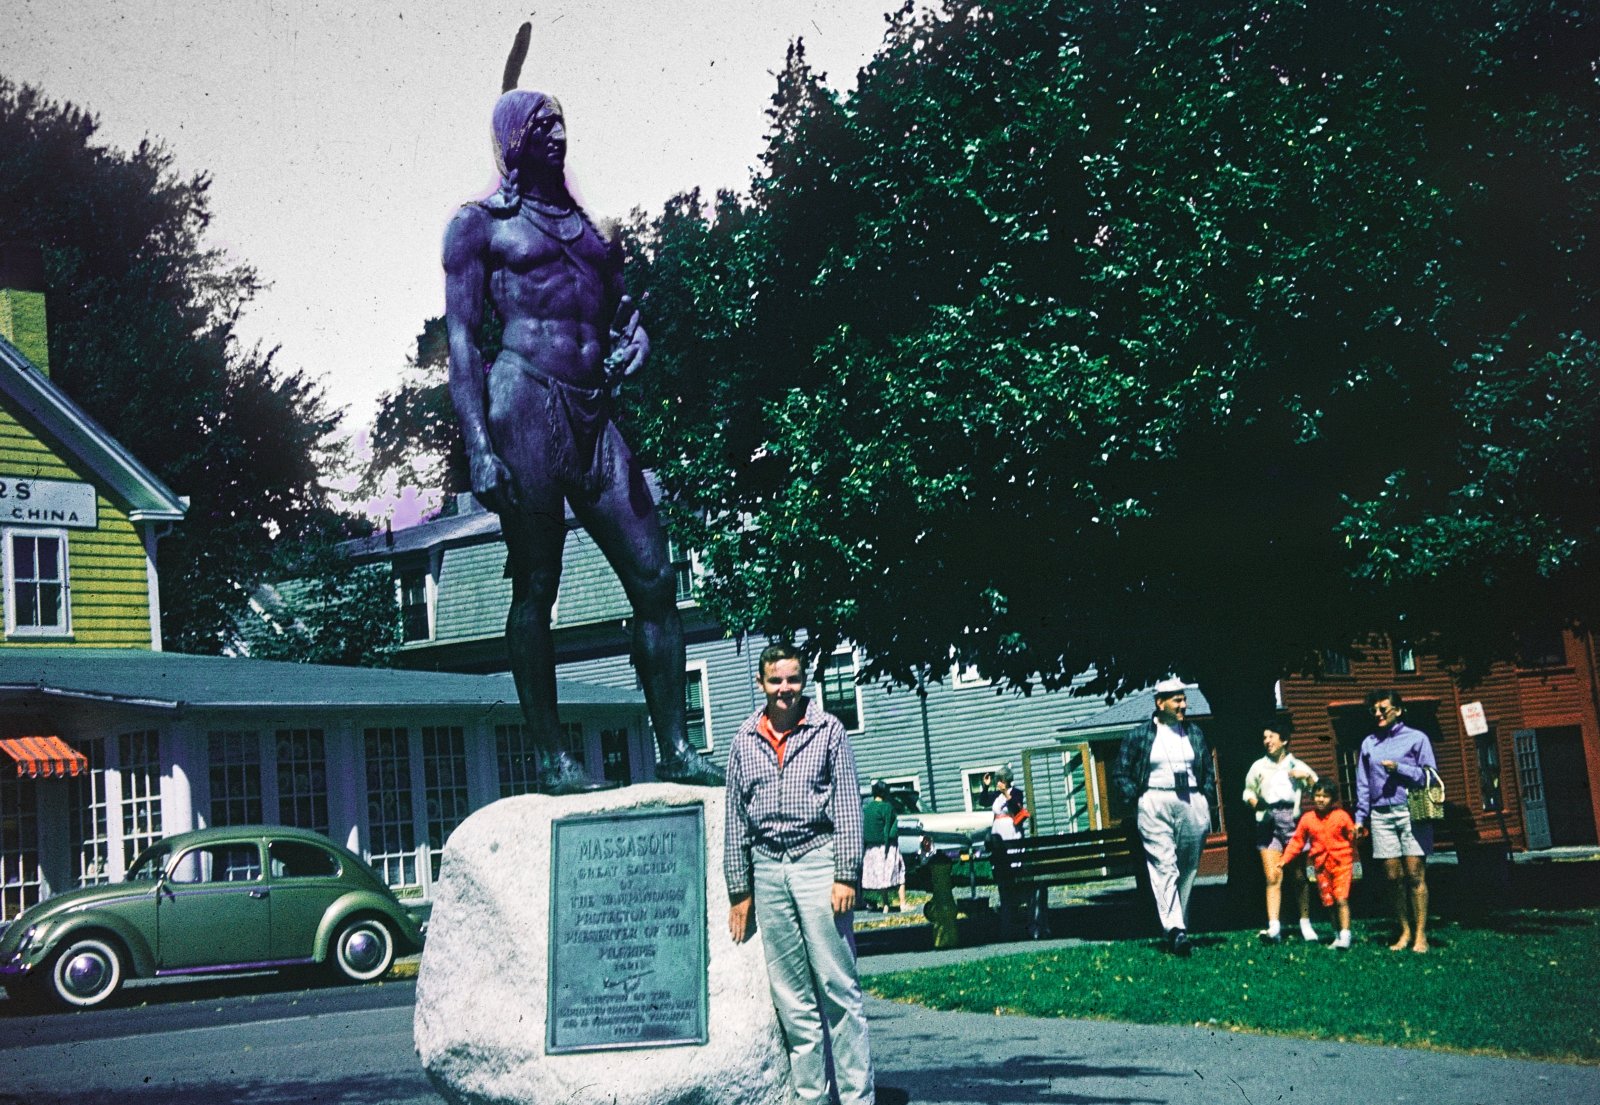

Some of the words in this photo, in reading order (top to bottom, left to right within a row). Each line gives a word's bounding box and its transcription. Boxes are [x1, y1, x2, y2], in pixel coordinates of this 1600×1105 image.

[12, 508, 79, 522] CHINA
[579, 832, 677, 860] MASSASOIT
[577, 866, 618, 879] GREAT
[626, 862, 677, 876] SACHEM
[570, 895, 595, 908] THE
[654, 906, 680, 919] AND
[667, 923, 691, 937] THE
